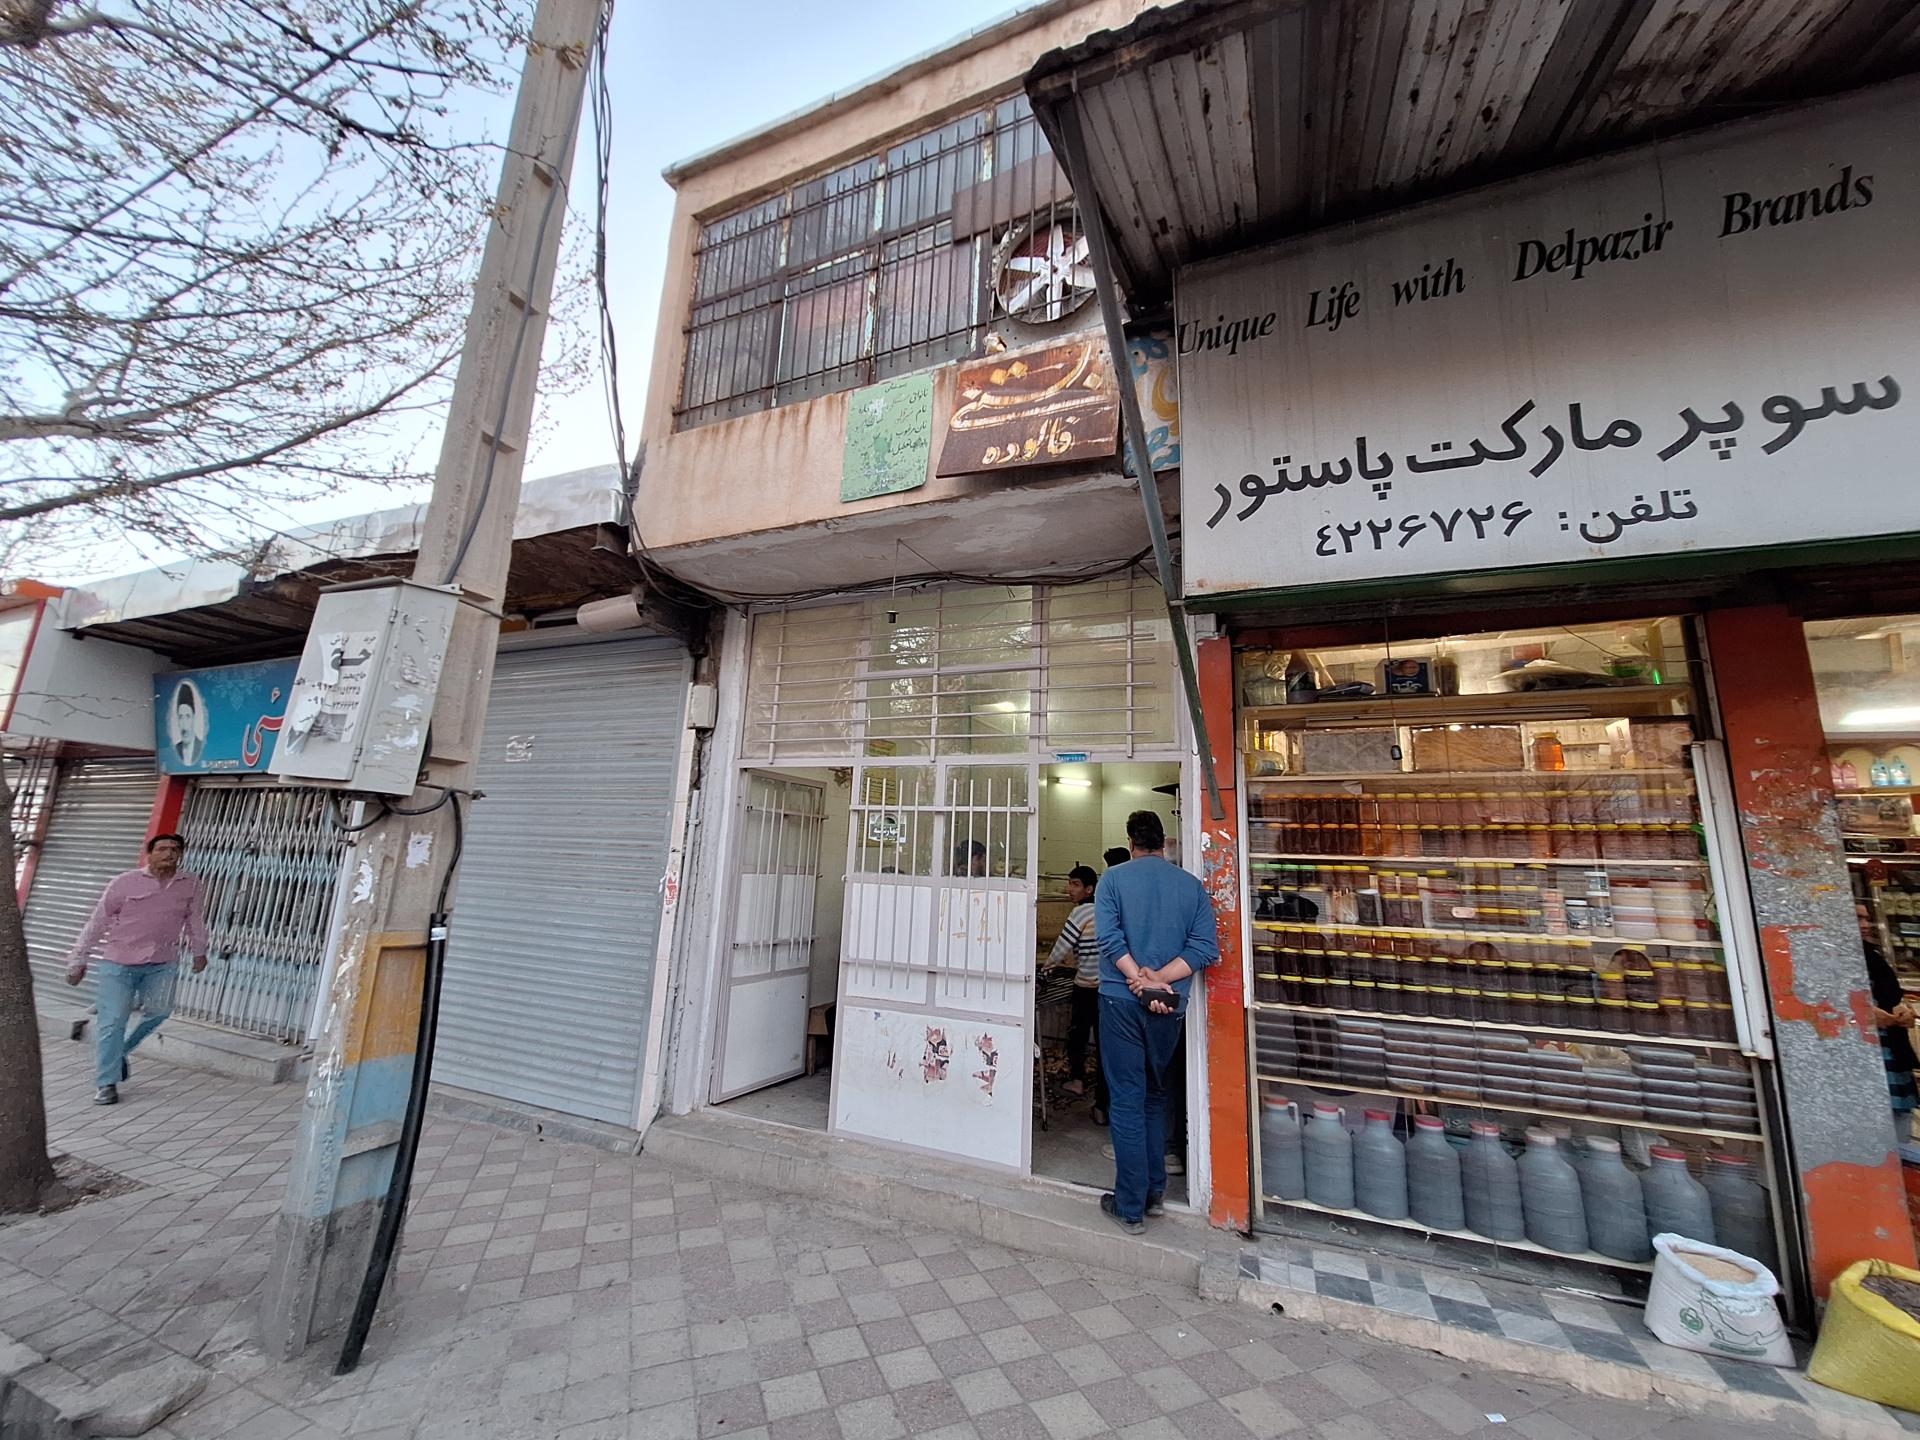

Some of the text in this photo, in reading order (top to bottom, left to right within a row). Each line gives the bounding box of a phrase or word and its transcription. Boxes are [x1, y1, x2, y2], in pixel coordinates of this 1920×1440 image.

[1177, 166, 1874, 356] Unique Life with Delpazir Brands
[981, 416, 1081, 465] فالوده
[1206, 375, 1902, 529] سوپر مارکت پاستور
